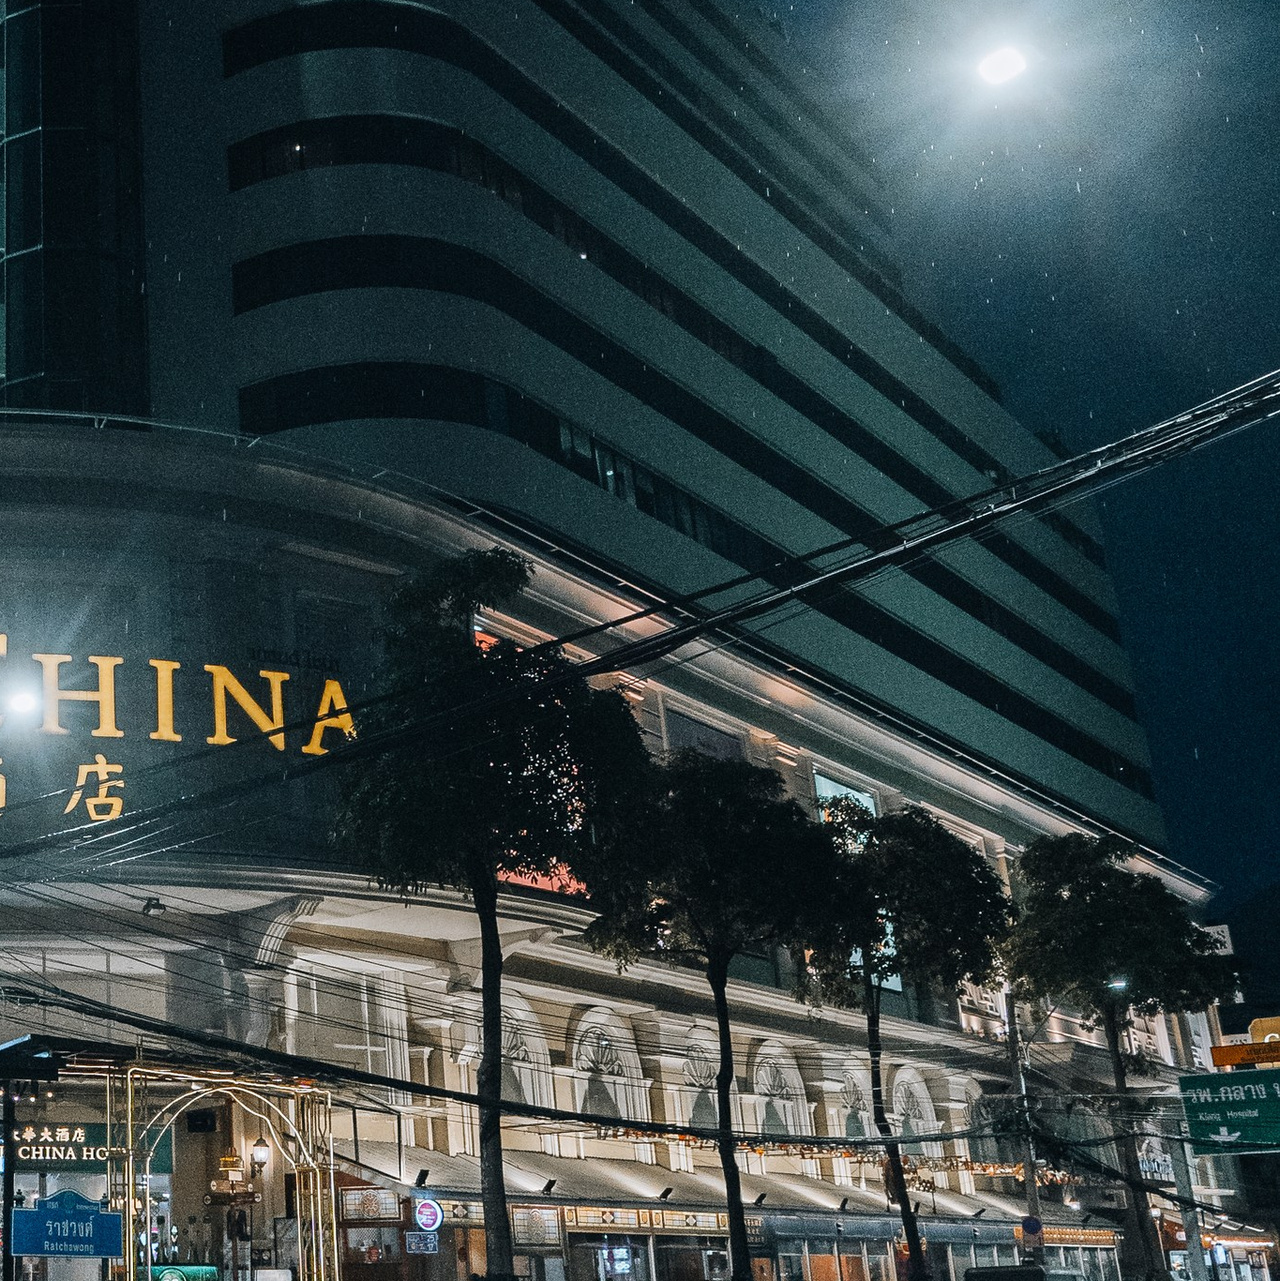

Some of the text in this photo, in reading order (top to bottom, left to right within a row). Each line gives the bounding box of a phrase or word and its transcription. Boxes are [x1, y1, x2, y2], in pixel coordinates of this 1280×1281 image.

[18, 1146, 76, 1160] CHINA
[46, 1215, 95, 1238] ราชวงศ์
[44, 1241, 95, 1255] Ratchawong
